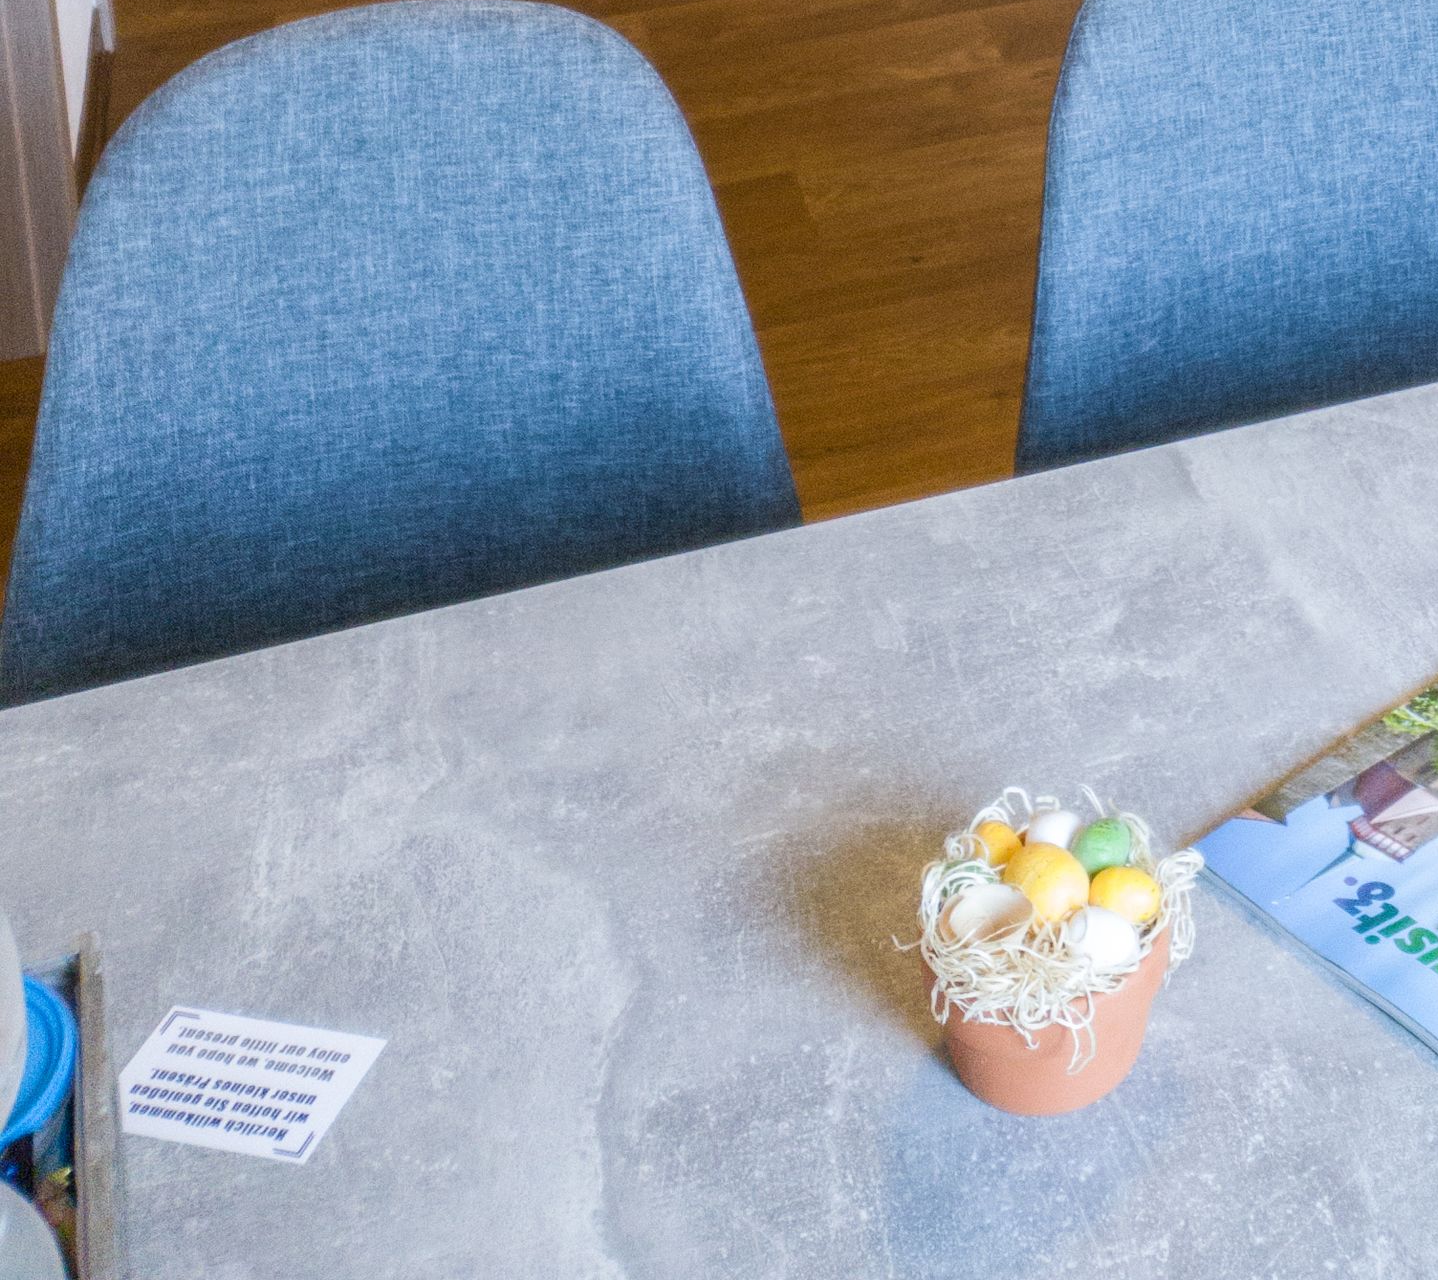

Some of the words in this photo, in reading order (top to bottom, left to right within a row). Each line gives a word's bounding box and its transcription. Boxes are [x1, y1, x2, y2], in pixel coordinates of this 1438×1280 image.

[178, 1026, 239, 1048] present.
[240, 1037, 277, 1054] little
[166, 1043, 194, 1057] you
[196, 1046, 235, 1065] hope
[280, 1043, 306, 1057] our
[309, 1048, 351, 1064] enjoy
[236, 1055, 259, 1069] we
[264, 1058, 335, 1082] Welcome,
[129, 1084, 202, 1109] genießen
[213, 1079, 270, 1100] kleines
[271, 1090, 317, 1106] unser
[205, 1097, 229, 1112] Sie
[231, 1102, 282, 1122] hoffen
[128, 1101, 224, 1129] willkommen,
[286, 1111, 309, 1124] wir
[224, 1119, 289, 1141] Herzlich
